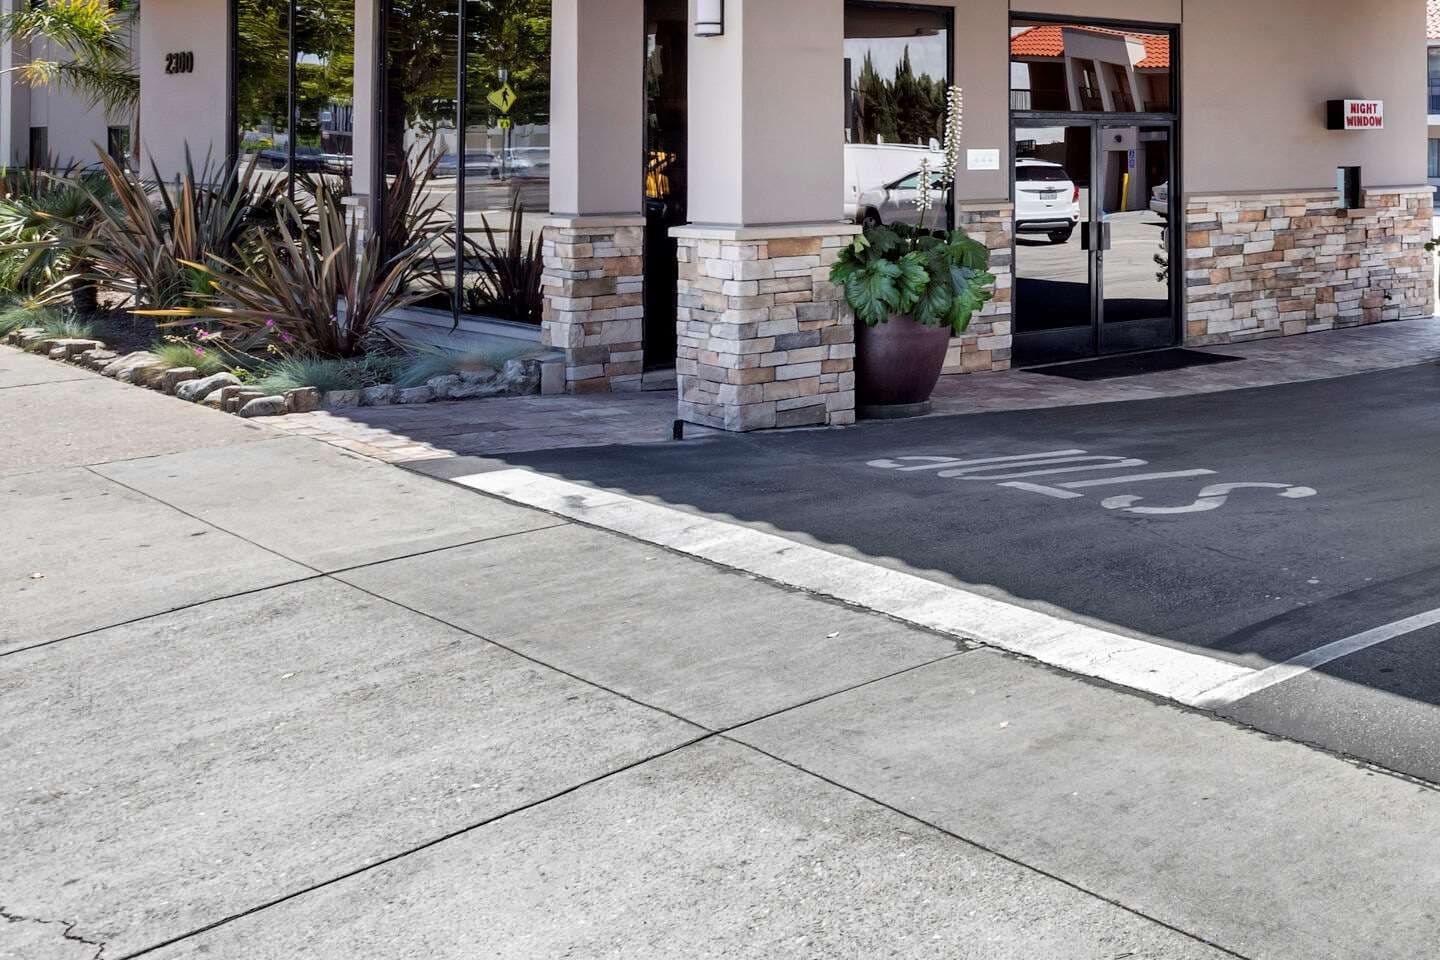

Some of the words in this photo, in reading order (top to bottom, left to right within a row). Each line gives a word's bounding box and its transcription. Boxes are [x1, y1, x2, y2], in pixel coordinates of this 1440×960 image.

[1350, 103, 1377, 114] NIGHT
[1346, 116, 1382, 127] WINDOW
[865, 448, 1318, 515] STOP
